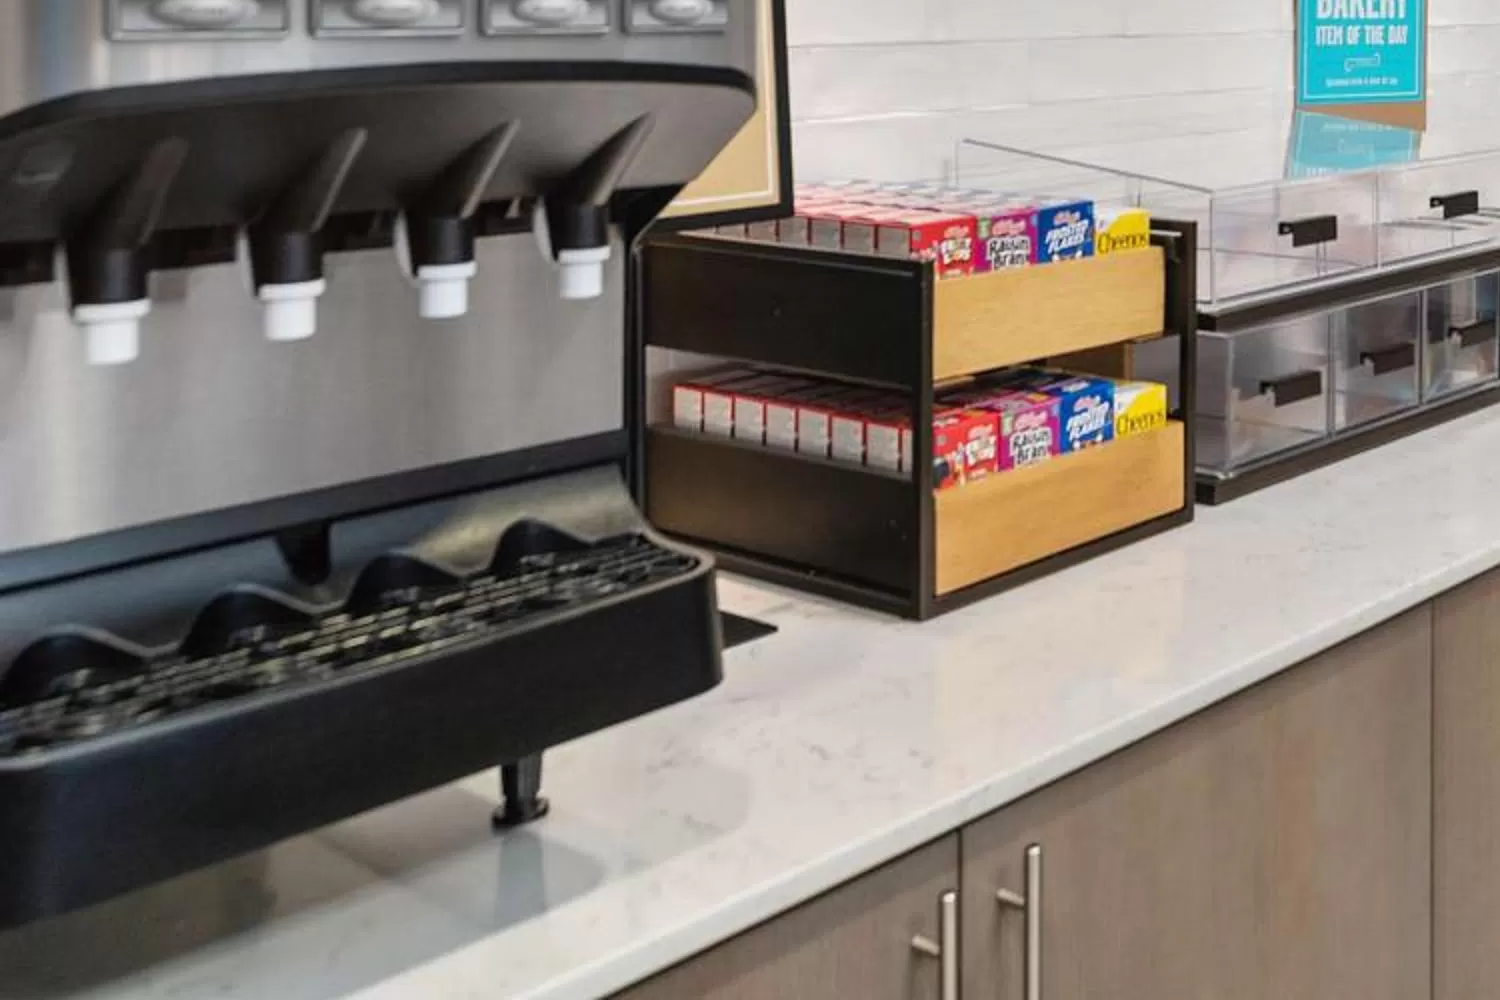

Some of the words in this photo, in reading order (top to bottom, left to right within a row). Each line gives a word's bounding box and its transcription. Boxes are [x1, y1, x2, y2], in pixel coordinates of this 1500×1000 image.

[1315, 24, 1343, 46] ITEM
[1347, 25, 1360, 45] OF
[1364, 24, 1385, 45] THE
[1388, 24, 1408, 45] DAY
[988, 237, 1029, 257] Raisin
[1097, 232, 1148, 255] Cheerios
[993, 253, 1027, 269] Bran
[1116, 411, 1165, 435] Cheerios
[1012, 428, 1050, 449] Raisin
[1016, 446, 1046, 464] Bran
